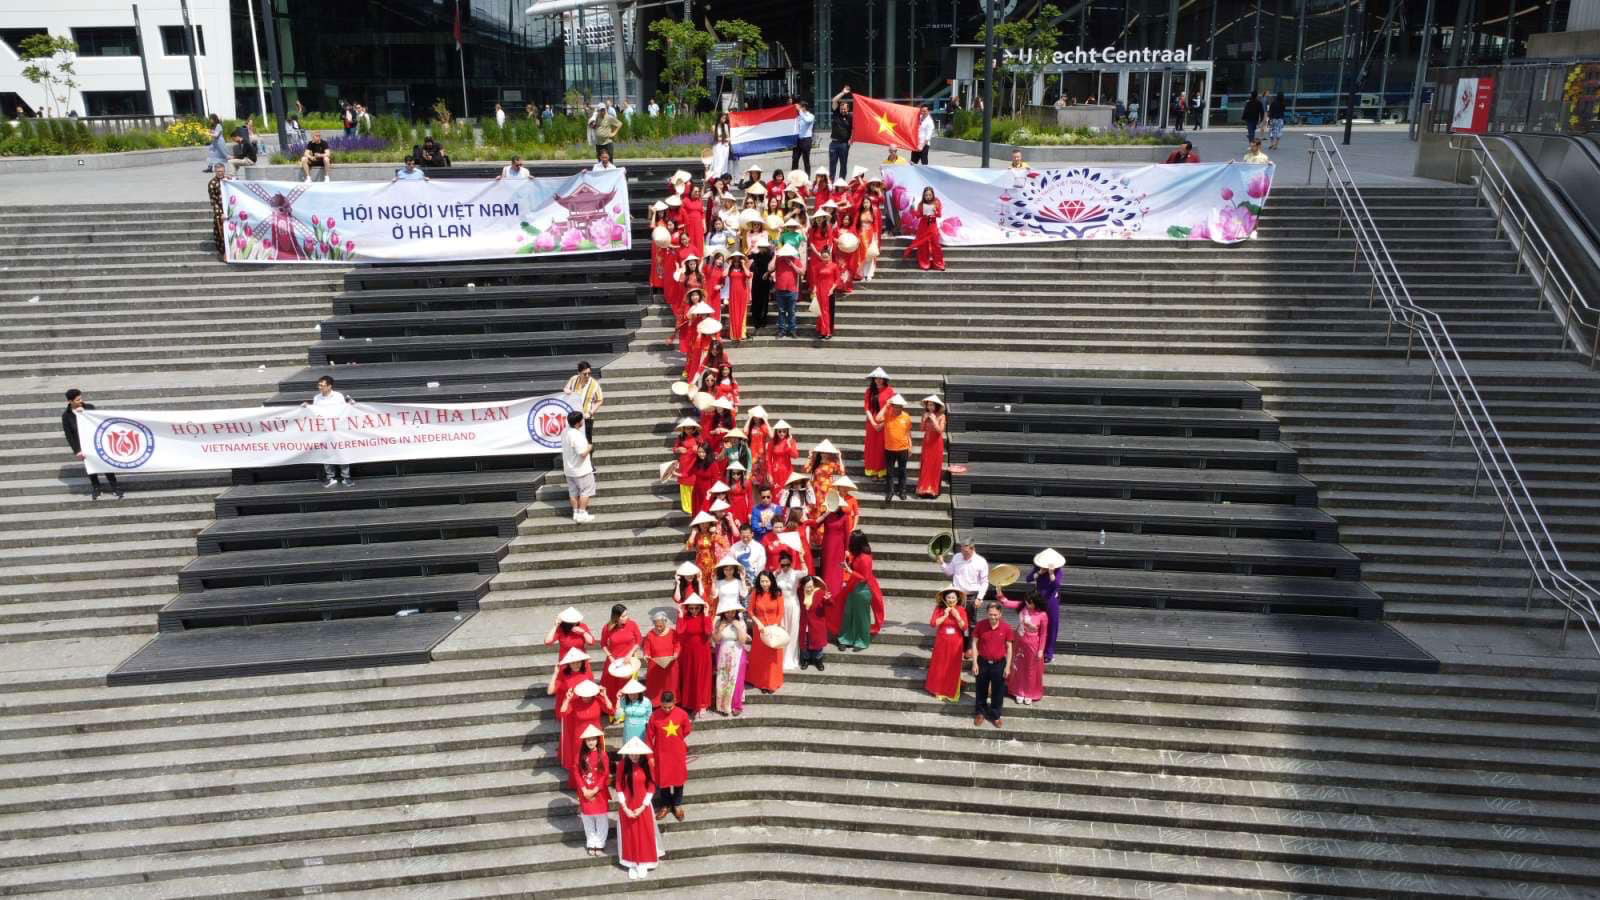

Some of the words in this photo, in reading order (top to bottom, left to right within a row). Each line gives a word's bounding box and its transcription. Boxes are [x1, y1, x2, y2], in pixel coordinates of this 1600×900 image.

[1102, 44, 1192, 64] Centraal
[342, 204, 373, 223] HỘI
[378, 202, 433, 220] NGƯỜI
[437, 201, 474, 220] VIỆT
[479, 203, 519, 217] NAM
[409, 222, 433, 239] HÀ
[438, 224, 472, 238] LAN
[212, 421, 253, 437] PHỤ
[347, 412, 392, 430] NAM
[396, 410, 431, 428] TẠI
[471, 407, 510, 421] LAN
[202, 442, 270, 453] VIETNAMESE
[273, 442, 328, 452] VROUWEN
[330, 437, 396, 450] VERENIGING
[400, 435, 410, 444] IN
[413, 432, 476, 444] NEDERLAND
